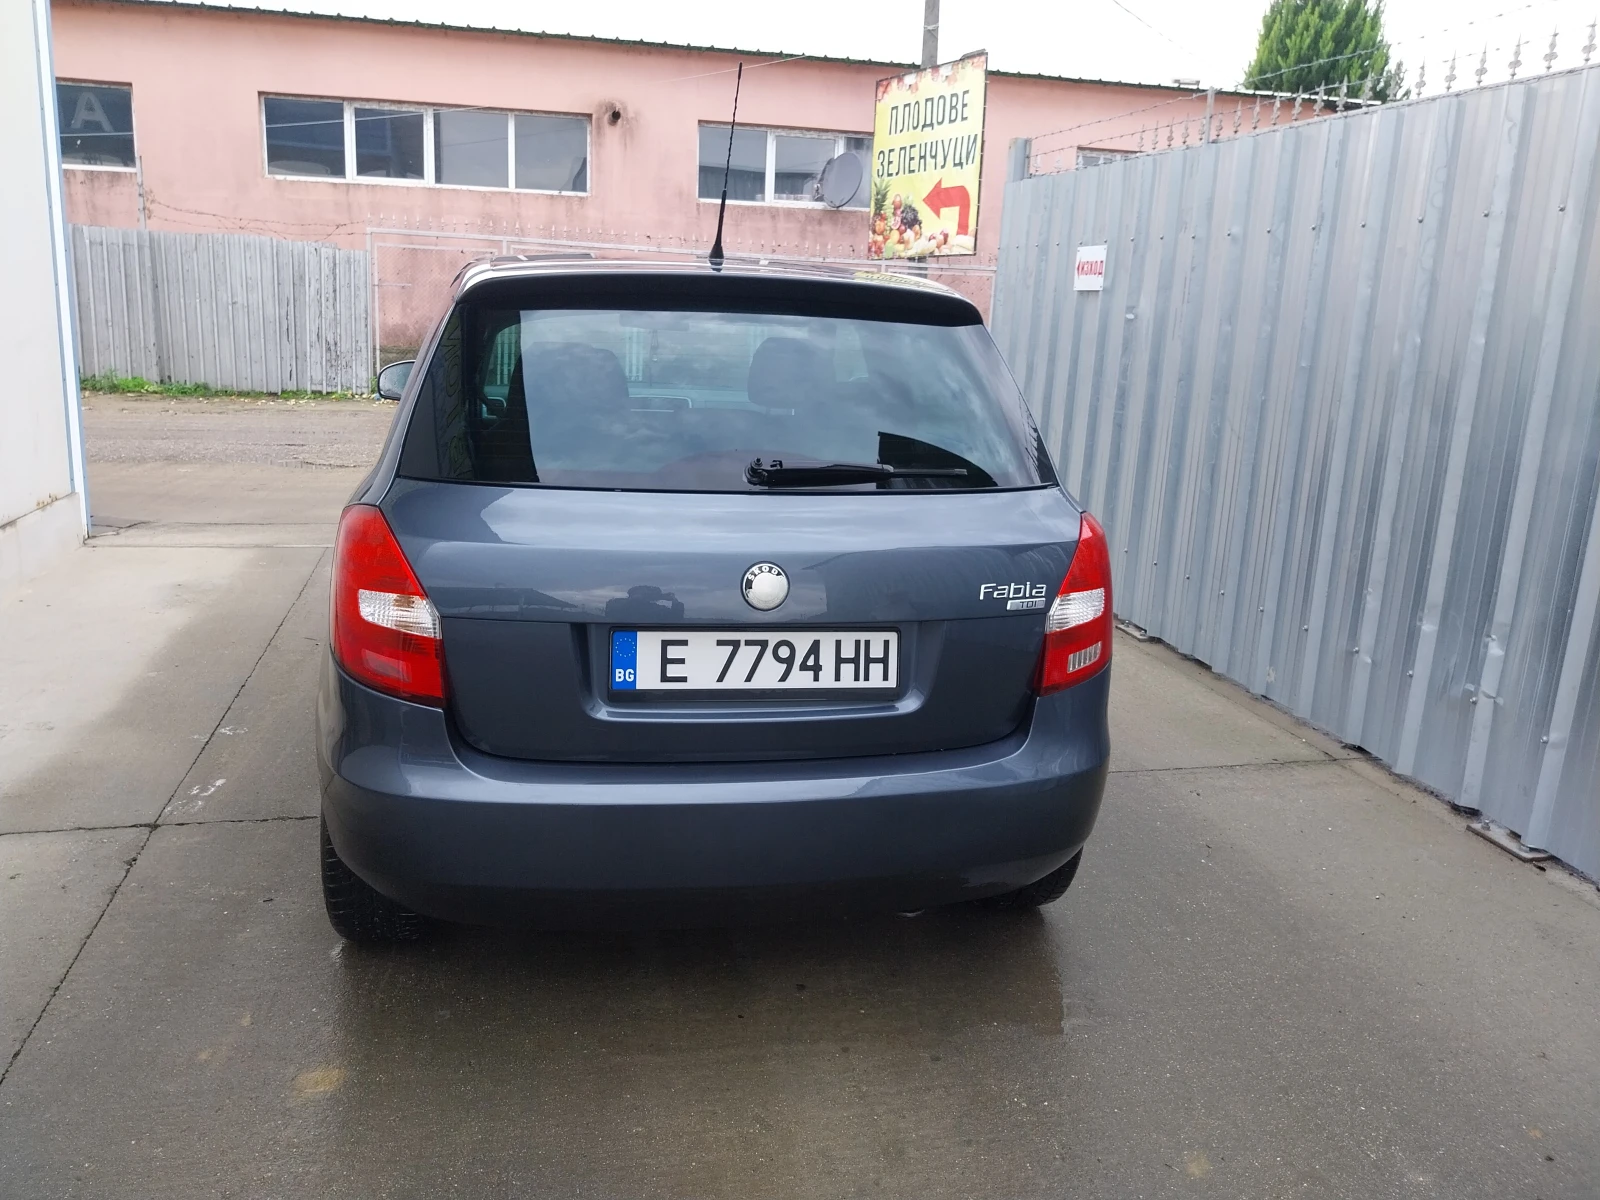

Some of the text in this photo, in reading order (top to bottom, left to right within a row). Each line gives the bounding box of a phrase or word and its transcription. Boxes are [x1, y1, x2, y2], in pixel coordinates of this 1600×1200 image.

[888, 90, 969, 135] ПЛОДОВЕ
[876, 133, 978, 178] ЗЕЛЕНЧУЦИ
[748, 565, 786, 581] SKOD
[979, 581, 1046, 600] Fabia
[1020, 600, 1037, 609] TDI
[660, 639, 689, 683] E
[716, 639, 823, 682] 7794
[615, 668, 635, 682] BG
